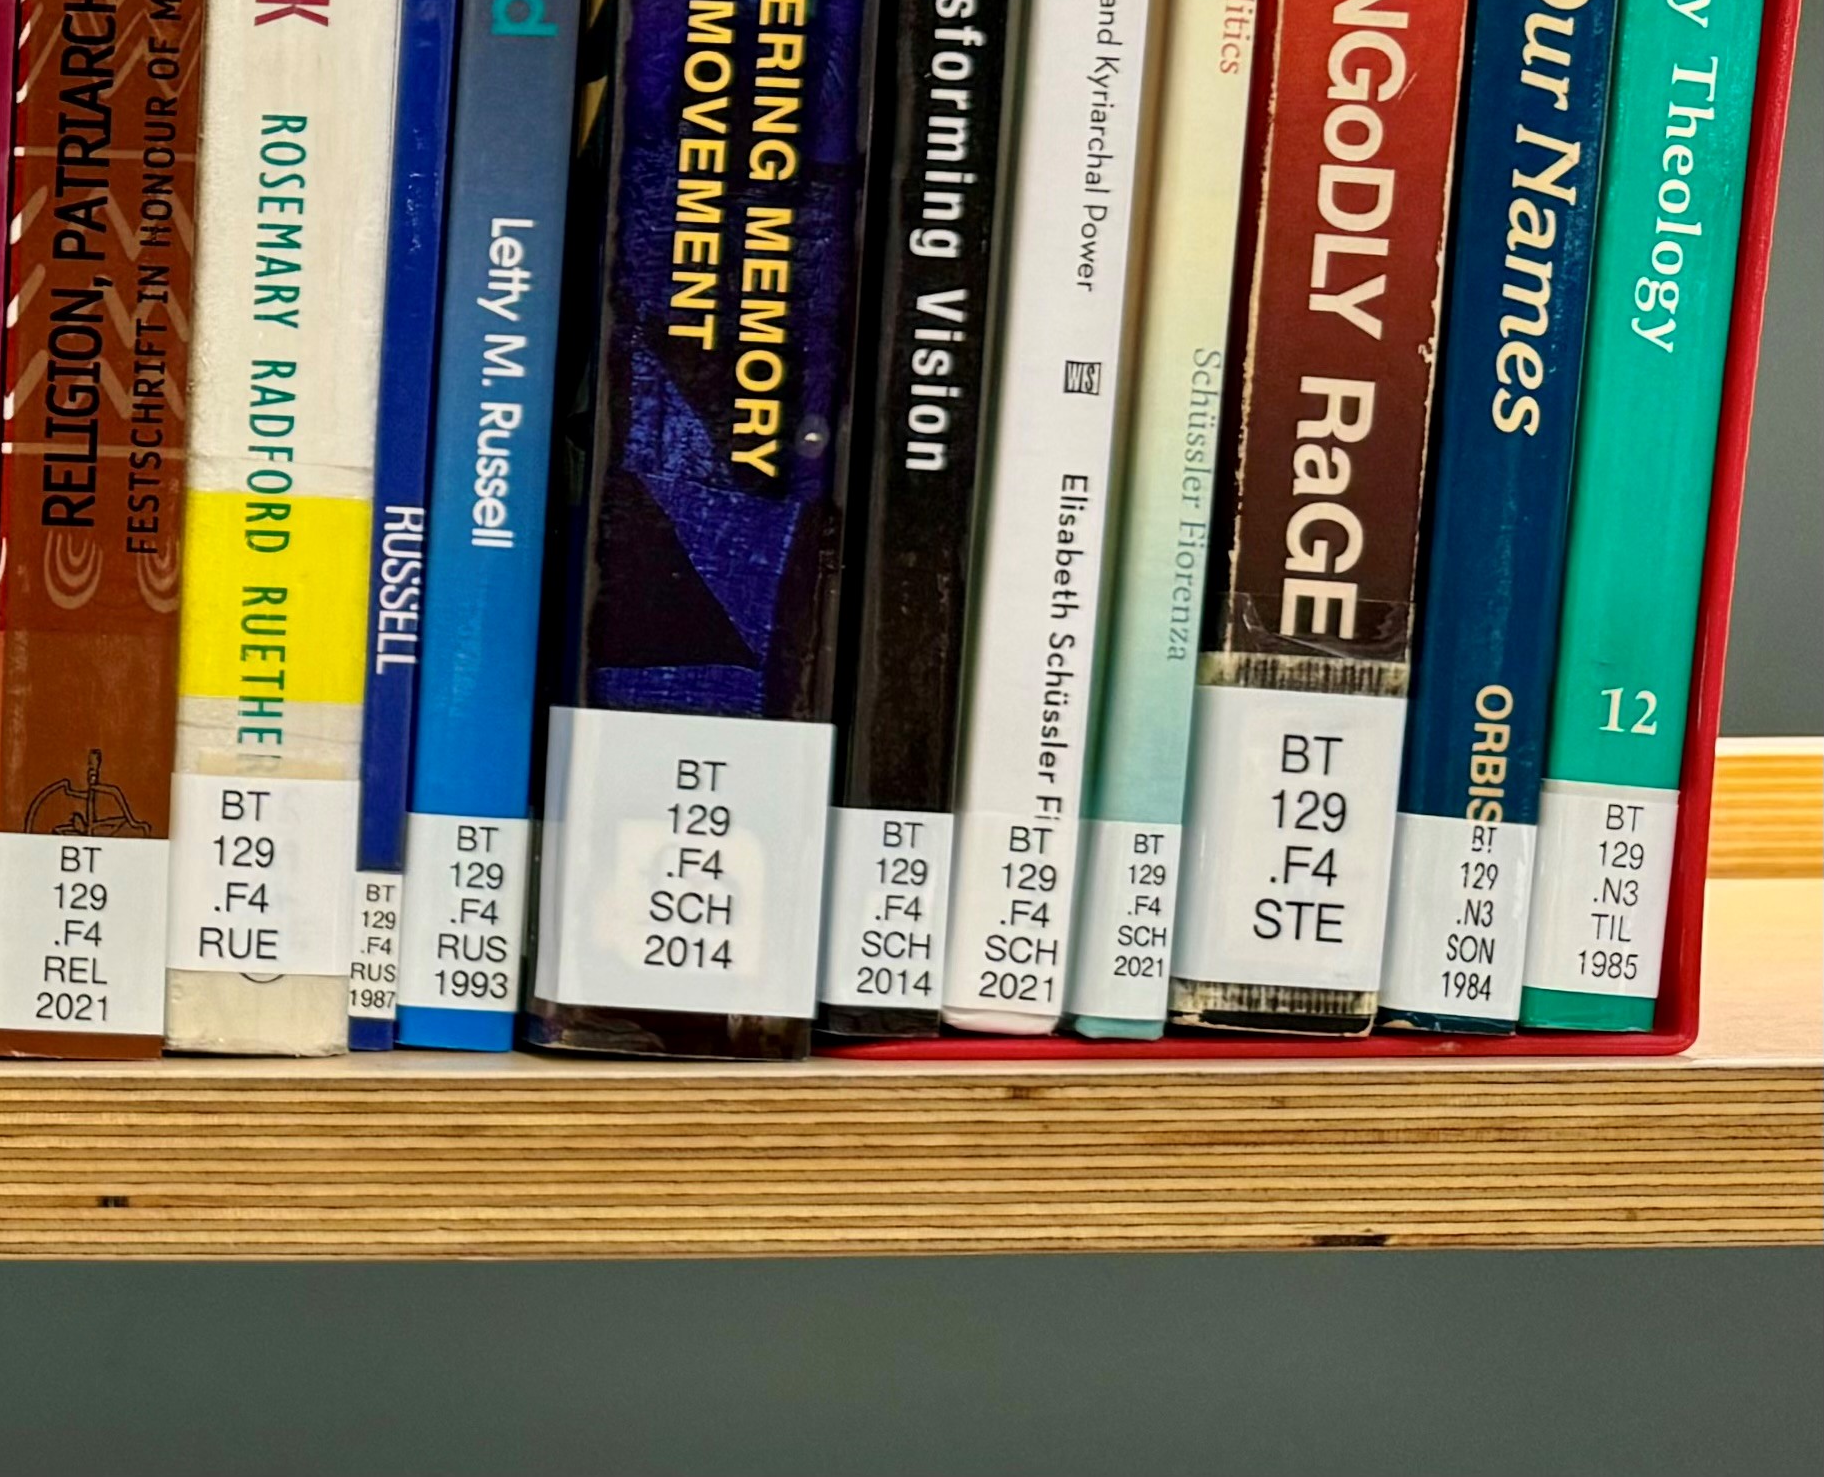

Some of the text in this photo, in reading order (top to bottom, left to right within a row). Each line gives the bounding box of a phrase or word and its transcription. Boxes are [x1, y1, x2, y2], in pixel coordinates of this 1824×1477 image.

[667, 0, 735, 350] MOVEMENT
[1630, 55, 1720, 354] Theology
[1491, 124, 1581, 436] Names
[245, 114, 308, 554] ROSEMARY RADFORD
[730, 208, 797, 478] MEMORY
[905, 289, 967, 473] Vision
[41, 275, 114, 528] RELIGION,
[1600, 687, 1657, 735] 12
[1467, 685, 1513, 825] ORBIS
[1606, 805, 1644, 831] BT
[1134, 834, 1164, 854] BT
[1599, 842, 1644, 869] 129
[1129, 866, 1166, 885] 129
[366, 883, 396, 903] BT
[1127, 897, 1160, 915] .F4
[1593, 879, 1638, 906] .N3
[362, 911, 396, 929] 129
[1591, 914, 1632, 942] TIL
[361, 937, 392, 955] .F4
[1117, 927, 1167, 947] SCH
[350, 962, 396, 982] RUS
[1115, 956, 1163, 977] 2021
[1579, 950, 1637, 980] 1985
[350, 990, 396, 1009] 1987
